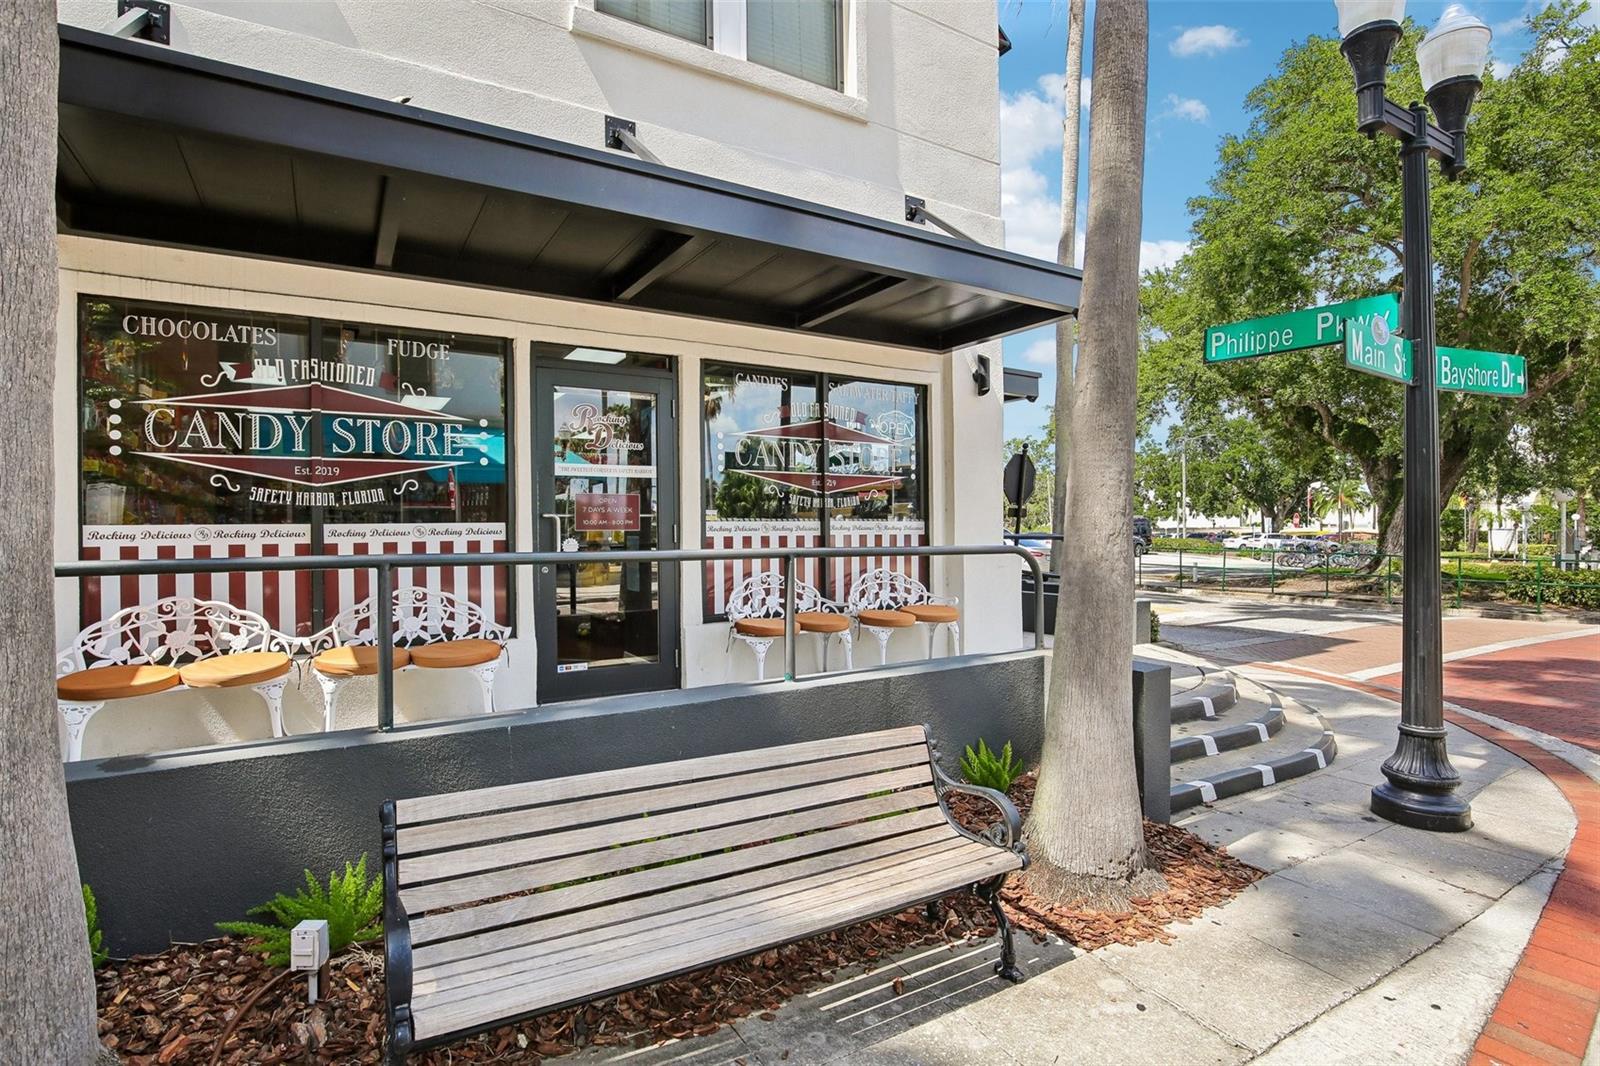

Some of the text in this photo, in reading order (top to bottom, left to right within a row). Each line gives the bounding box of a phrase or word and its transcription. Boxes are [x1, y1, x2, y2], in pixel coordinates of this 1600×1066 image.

[122, 315, 277, 346] CHOCOLATES
[1211, 329, 1293, 357] Philippe
[387, 338, 450, 361] FUDGE
[1352, 327, 1385, 368] Main
[1394, 342, 1407, 376] St
[290, 358, 375, 387] FASHIONED
[735, 373, 788, 392] CANDIES
[1441, 355, 1498, 388] Bayshore
[1501, 361, 1516, 388] Dr
[144, 408, 464, 457] CANDY STORE
[569, 402, 627, 435] Rocking
[879, 421, 912, 436] OPEN
[585, 422, 644, 450] Delicious
[735, 439, 821, 468] CANDY
[294, 466, 340, 475] Est. 2019
[249, 487, 385, 507] SAFETY HARBOR, FLORIDA
[87, 531, 136, 542] Rocking
[140, 530, 192, 540] Delicious
[213, 530, 257, 540] Rocking
[260, 529, 306, 538] Delicious
[327, 529, 367, 538] Rocking
[369, 528, 411, 537] Delicious
[427, 528, 463, 537] Rocking
[465, 527, 503, 535] Delicious
[707, 525, 732, 533] Rocking
